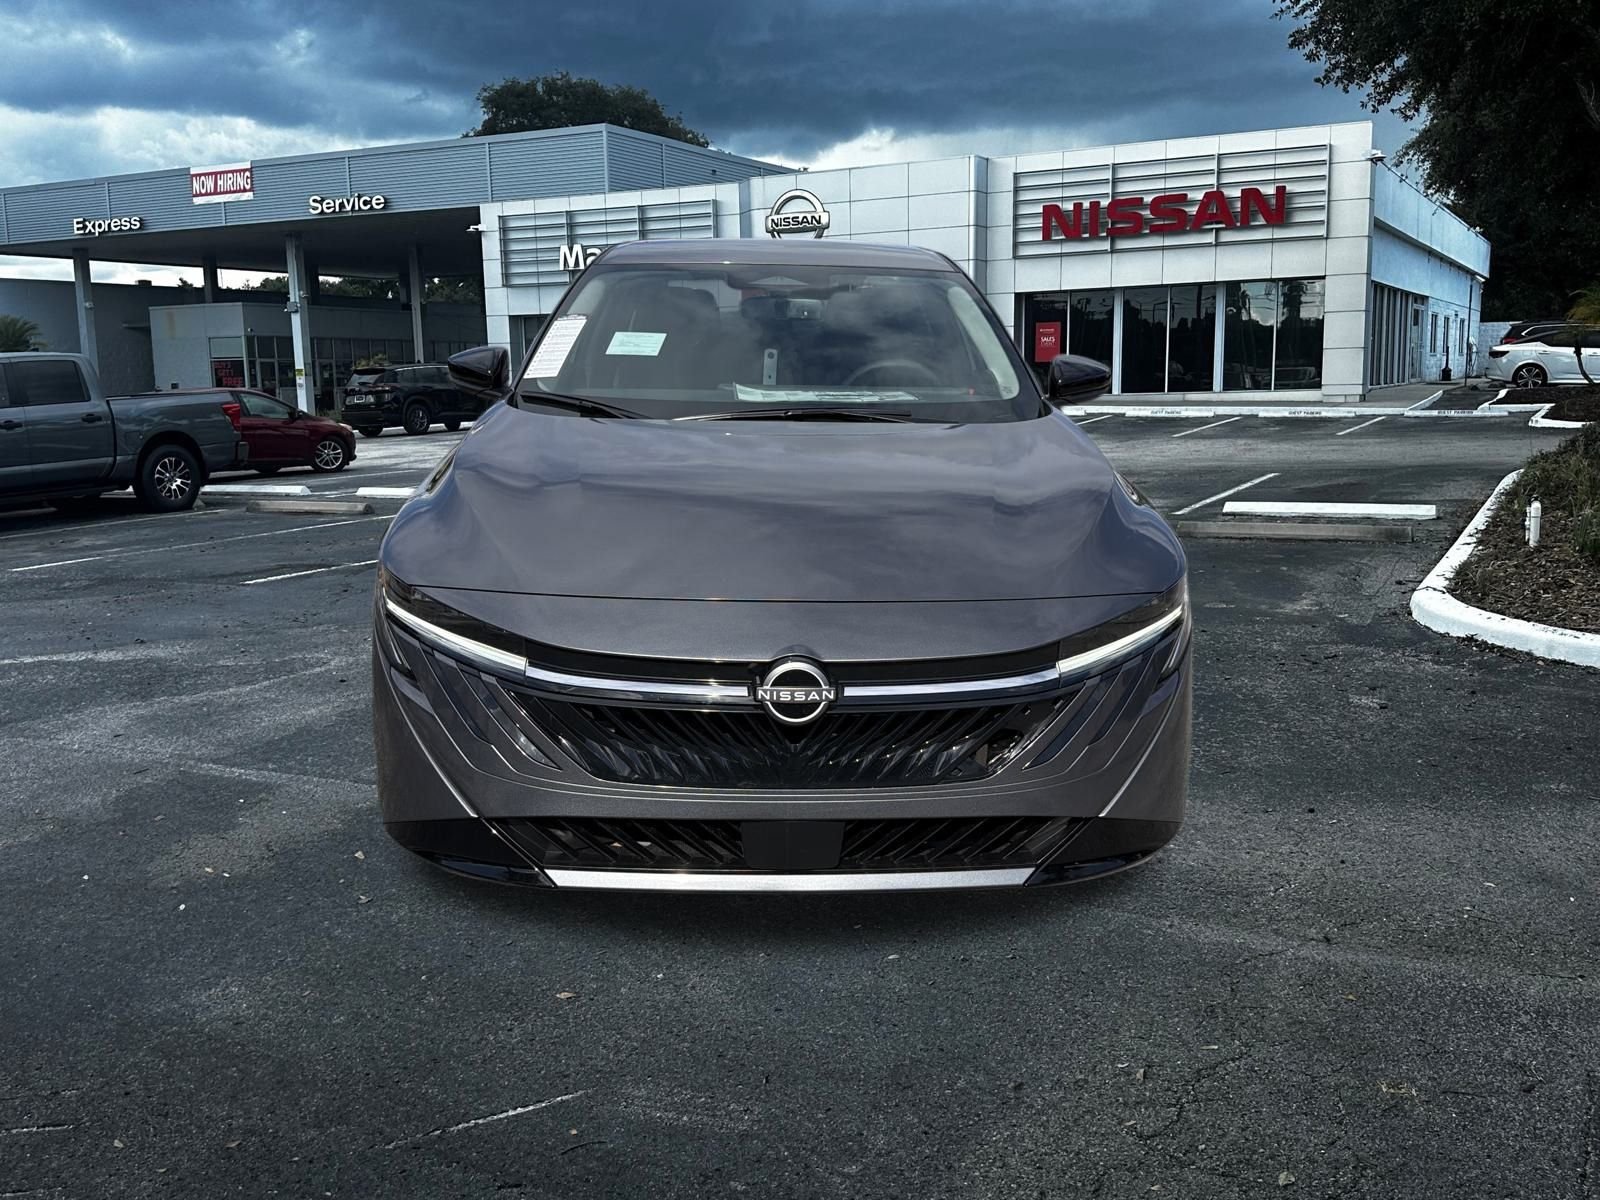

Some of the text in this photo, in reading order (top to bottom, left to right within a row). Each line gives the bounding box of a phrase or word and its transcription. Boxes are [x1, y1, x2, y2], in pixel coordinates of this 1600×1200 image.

[192, 171, 251, 195] NOW HIRING
[308, 193, 385, 215] Service
[1041, 185, 1287, 241] NISSAN
[73, 216, 141, 236] Express
[770, 214, 822, 229] NISSAN
[758, 690, 834, 701] NISSAN
